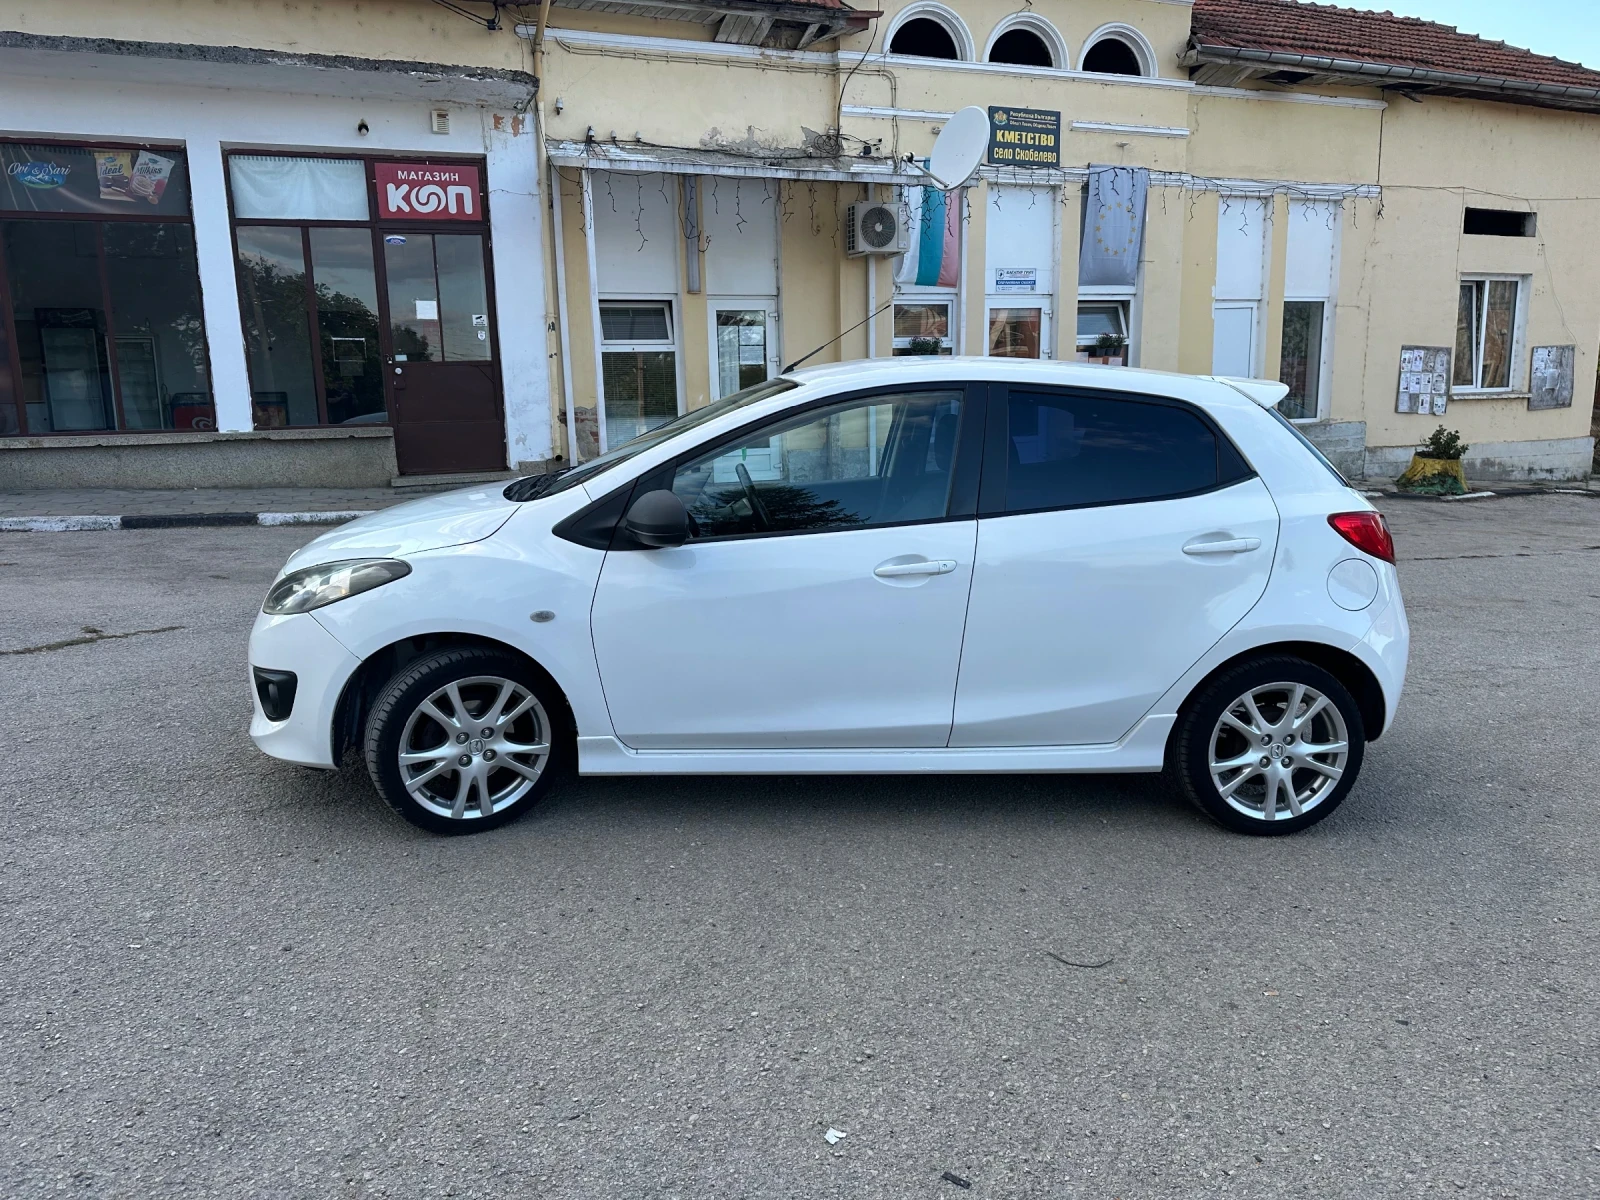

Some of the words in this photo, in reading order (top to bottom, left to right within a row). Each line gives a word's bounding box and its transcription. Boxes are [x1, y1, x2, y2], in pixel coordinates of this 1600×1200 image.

[996, 130, 1054, 146] КМЕТСТВО
[993, 147, 1013, 160] село
[1015, 148, 1057, 163] Скобелево
[7, 162, 30, 176] Ovi
[32, 167, 40, 175] &
[42, 161, 71, 176] Sari
[397, 170, 459, 182] МАГАЗИН
[386, 182, 473, 215] КОП
